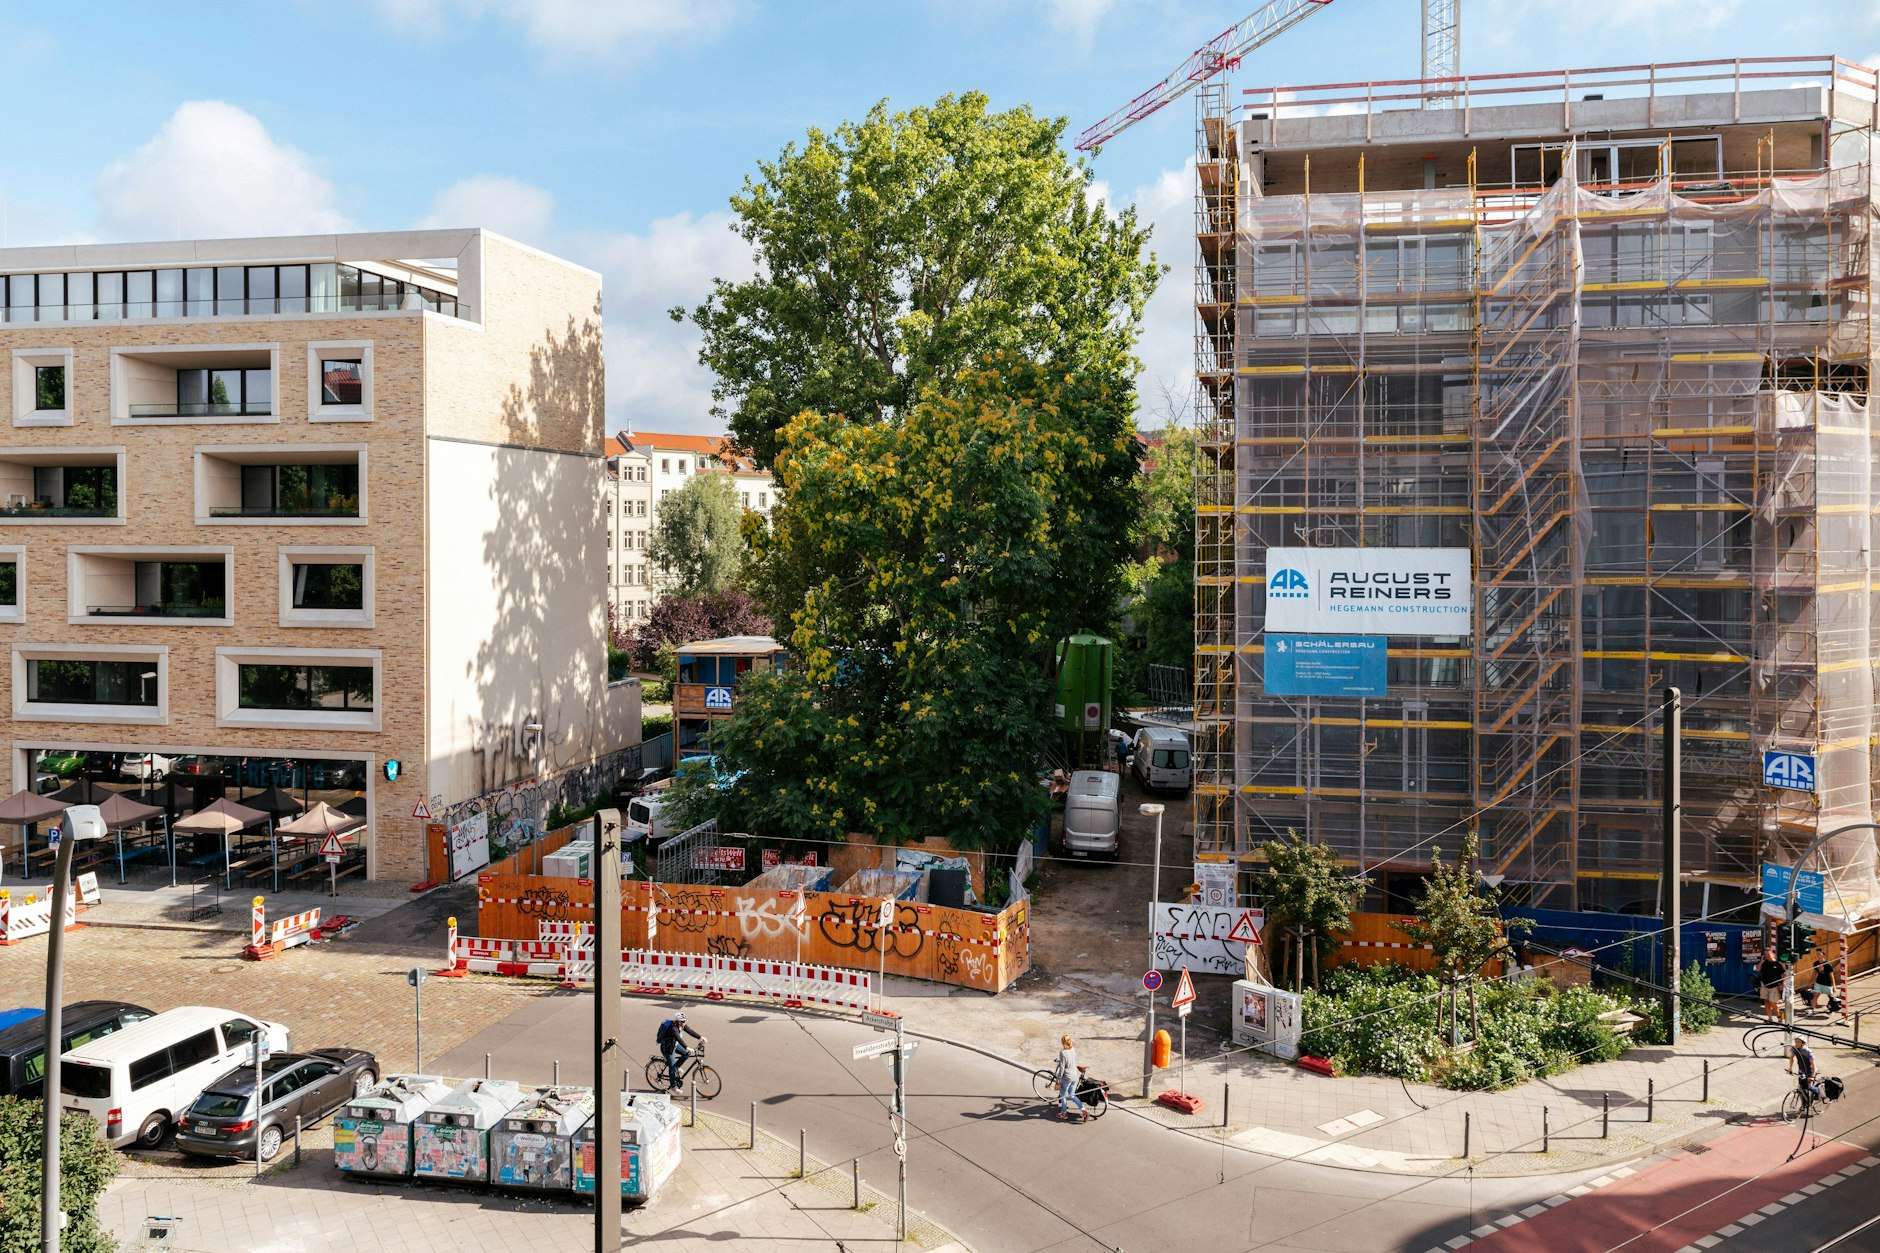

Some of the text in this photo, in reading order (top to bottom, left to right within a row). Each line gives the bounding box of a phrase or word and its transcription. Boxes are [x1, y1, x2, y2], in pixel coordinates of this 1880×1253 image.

[1270, 568, 1309, 590] AR
[1329, 572, 1452, 585] AUGUST
[1329, 587, 1452, 600] REINERS
[1329, 604, 1468, 614] HEGEMANN CONSTRUCTION
[1295, 640, 1375, 649] SCHÄLERBAU
[706, 688, 732, 703] AR
[1765, 754, 1814, 783] AR
[51, 830, 59, 841] P
[1741, 930, 1762, 938] CHOPIN
[865, 1014, 894, 1028] Ackerstraße
[855, 1040, 895, 1056] Invalidenstraße
